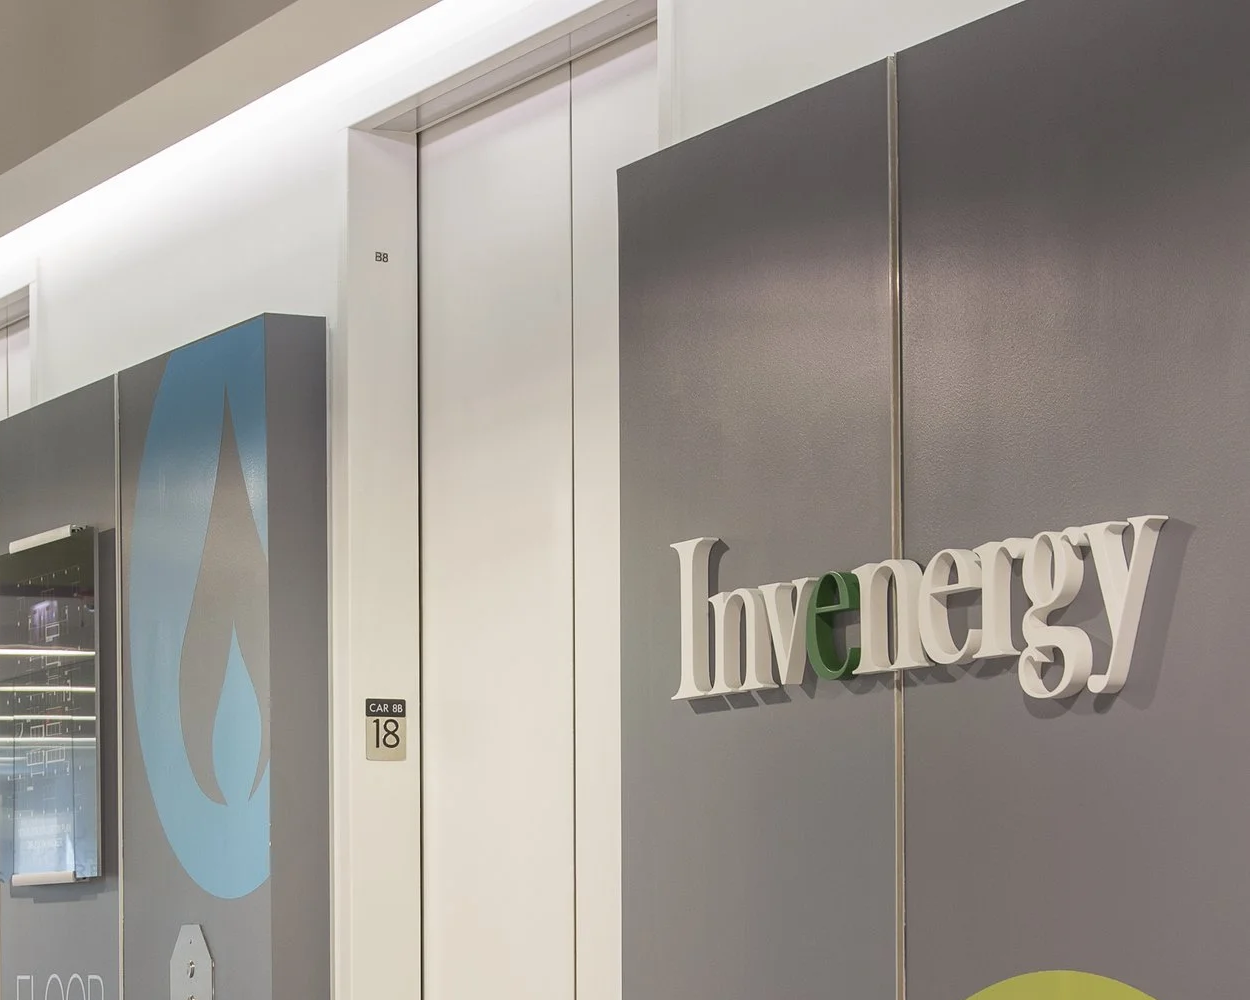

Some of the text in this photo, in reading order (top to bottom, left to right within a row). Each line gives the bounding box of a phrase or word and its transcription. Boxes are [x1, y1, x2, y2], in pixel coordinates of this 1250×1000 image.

[375, 251, 389, 263] B8
[670, 514, 1169, 700] Invenergy
[369, 703, 403, 713] CAR 8B
[372, 718, 400, 749] 18
